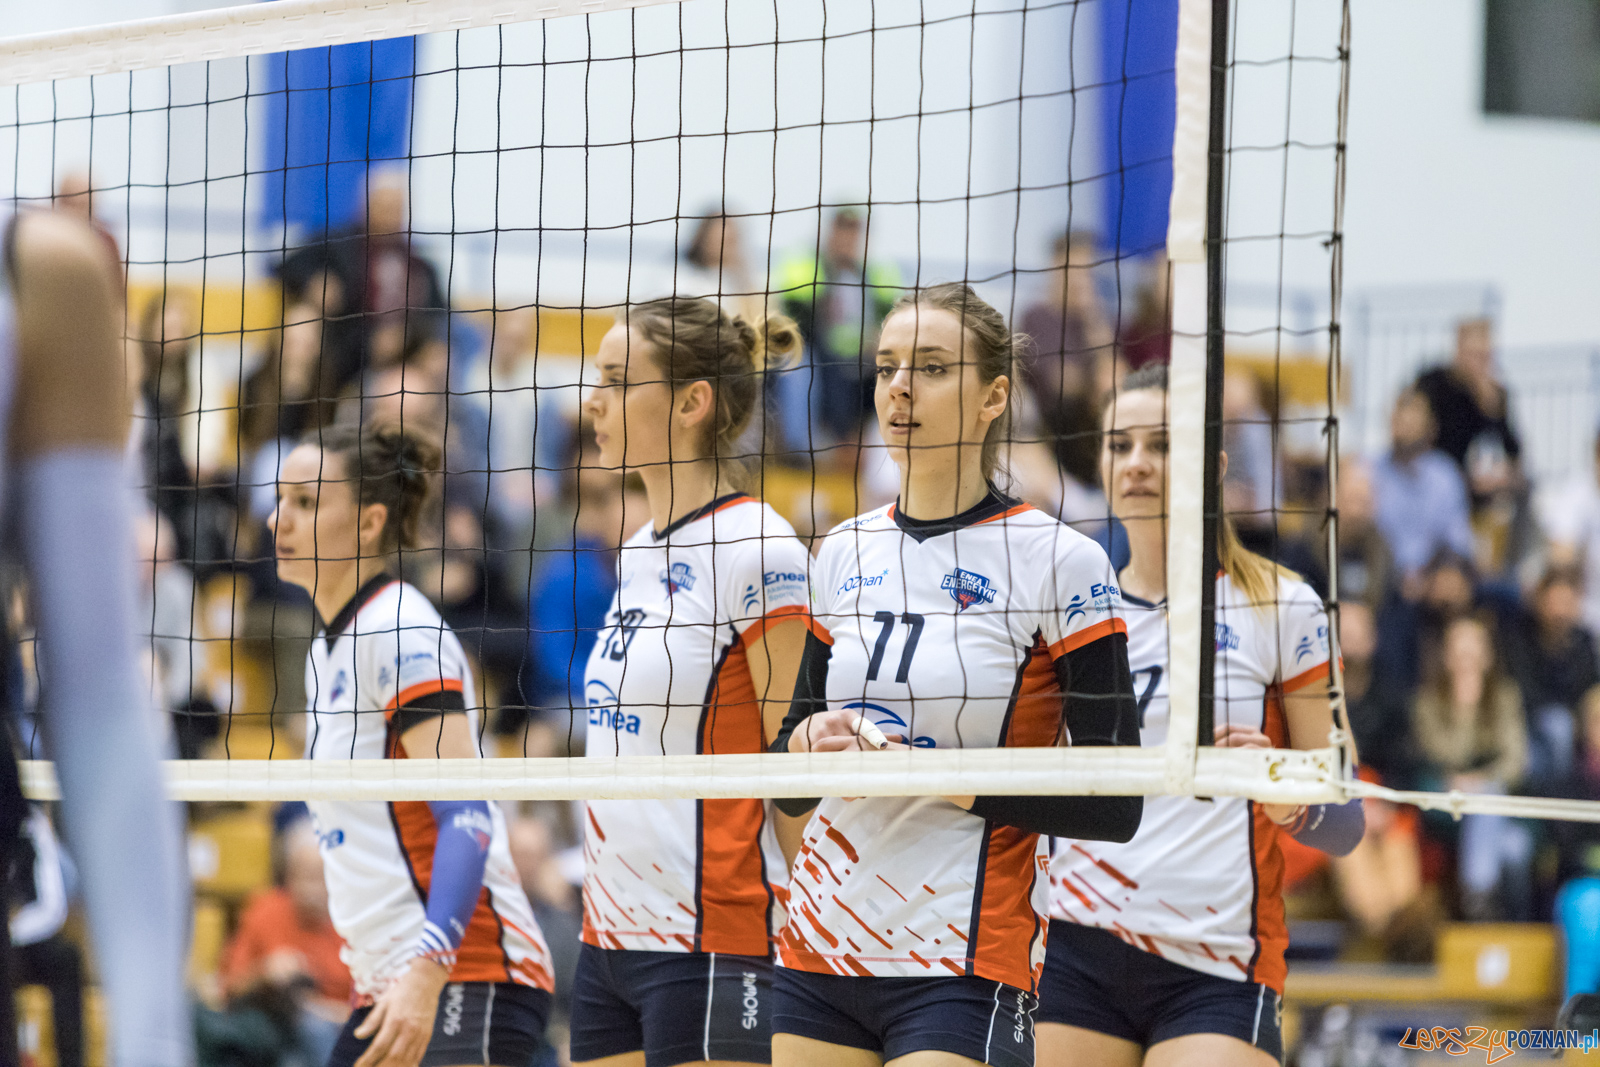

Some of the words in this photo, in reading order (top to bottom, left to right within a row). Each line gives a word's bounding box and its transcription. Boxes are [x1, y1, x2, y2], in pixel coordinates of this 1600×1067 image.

[763, 571, 806, 586] Enea
[942, 575, 996, 601] ENERGETYK
[960, 571, 983, 588] ENEA
[588, 698, 641, 736] Enea
